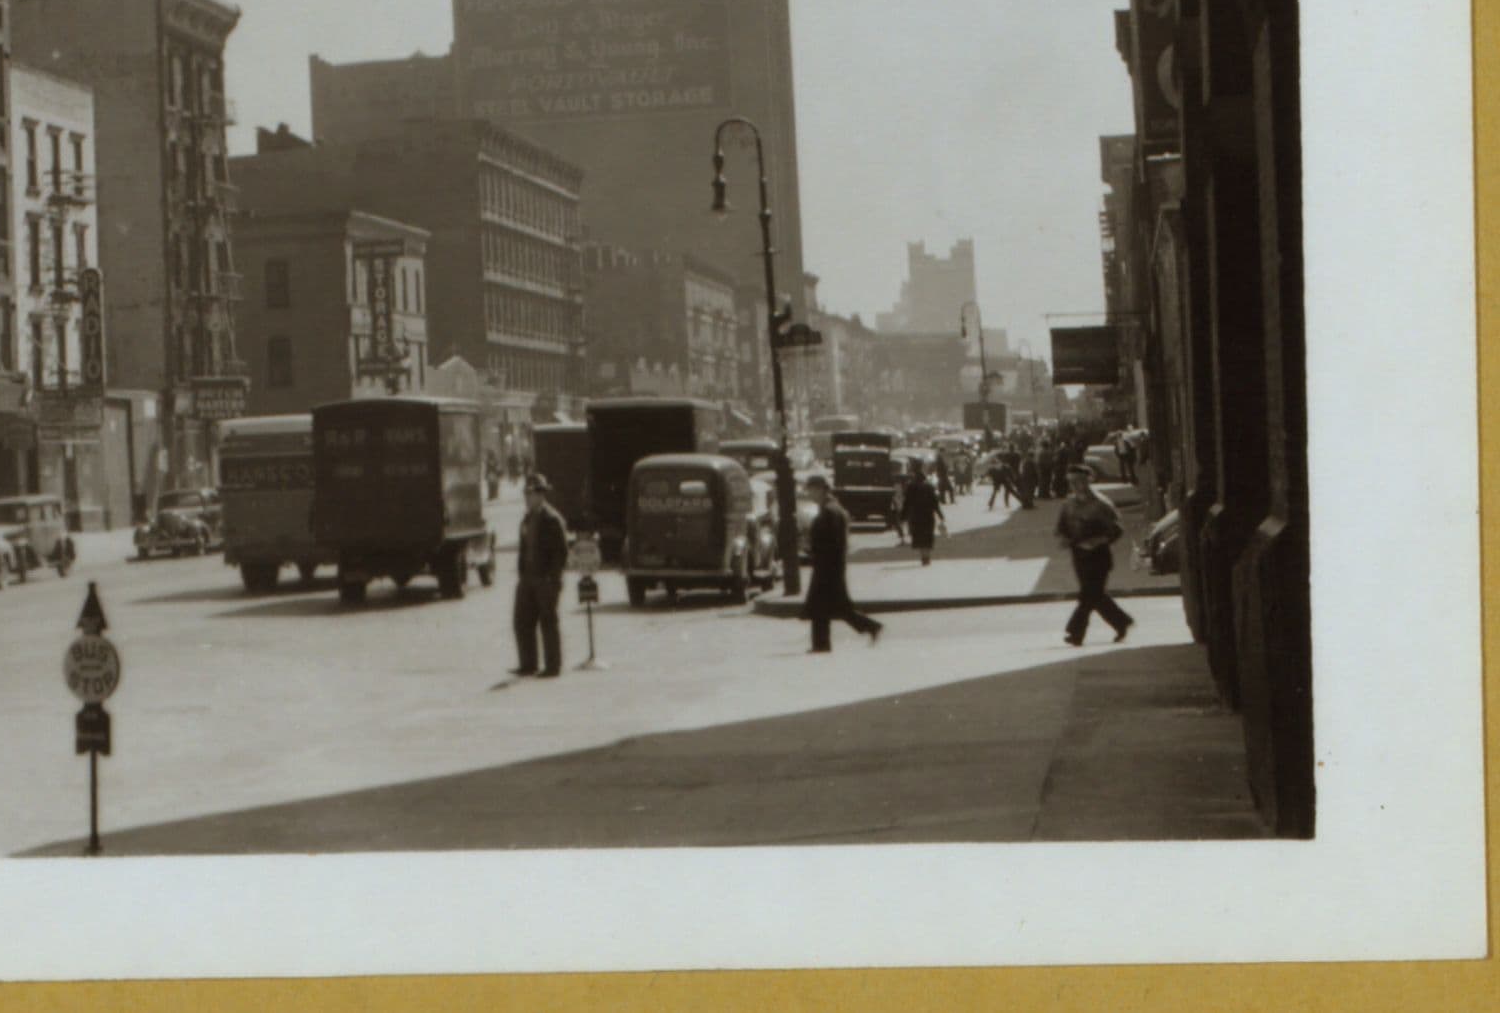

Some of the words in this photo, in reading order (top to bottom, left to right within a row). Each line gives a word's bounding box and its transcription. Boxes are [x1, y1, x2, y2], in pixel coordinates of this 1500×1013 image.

[538, 93, 601, 113] VAULT
[611, 84, 714, 110] STORAGE
[83, 273, 101, 380] RADIO
[71, 641, 109, 663] BUS
[69, 670, 114, 695] STOP
